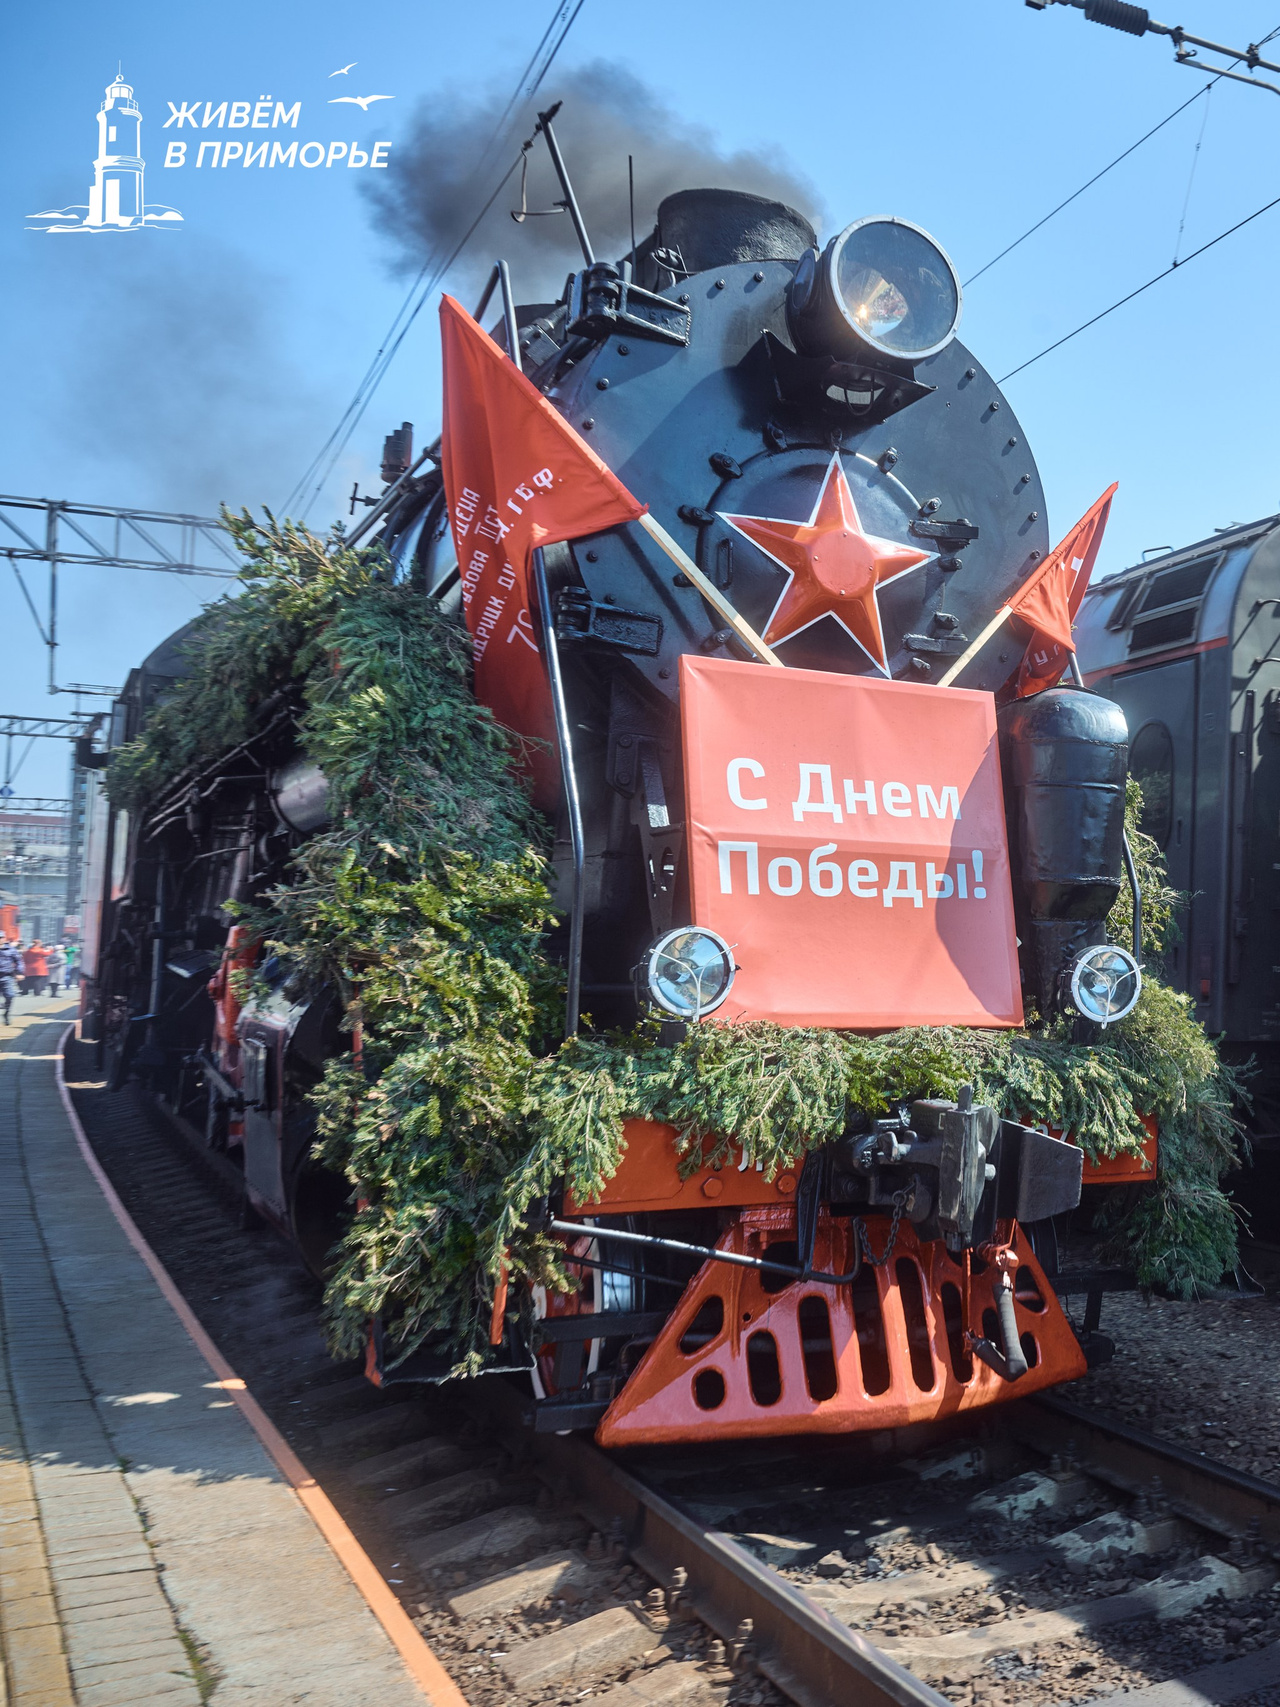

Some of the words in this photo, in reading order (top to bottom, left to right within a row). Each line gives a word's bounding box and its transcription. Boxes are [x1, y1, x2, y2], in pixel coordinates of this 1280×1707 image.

[455, 486, 481, 546] ДЕНА
[461, 549, 490, 611] УЗОВА
[726, 757, 768, 811] С
[791, 762, 962, 824] Днем
[717, 840, 988, 908] Победы!
